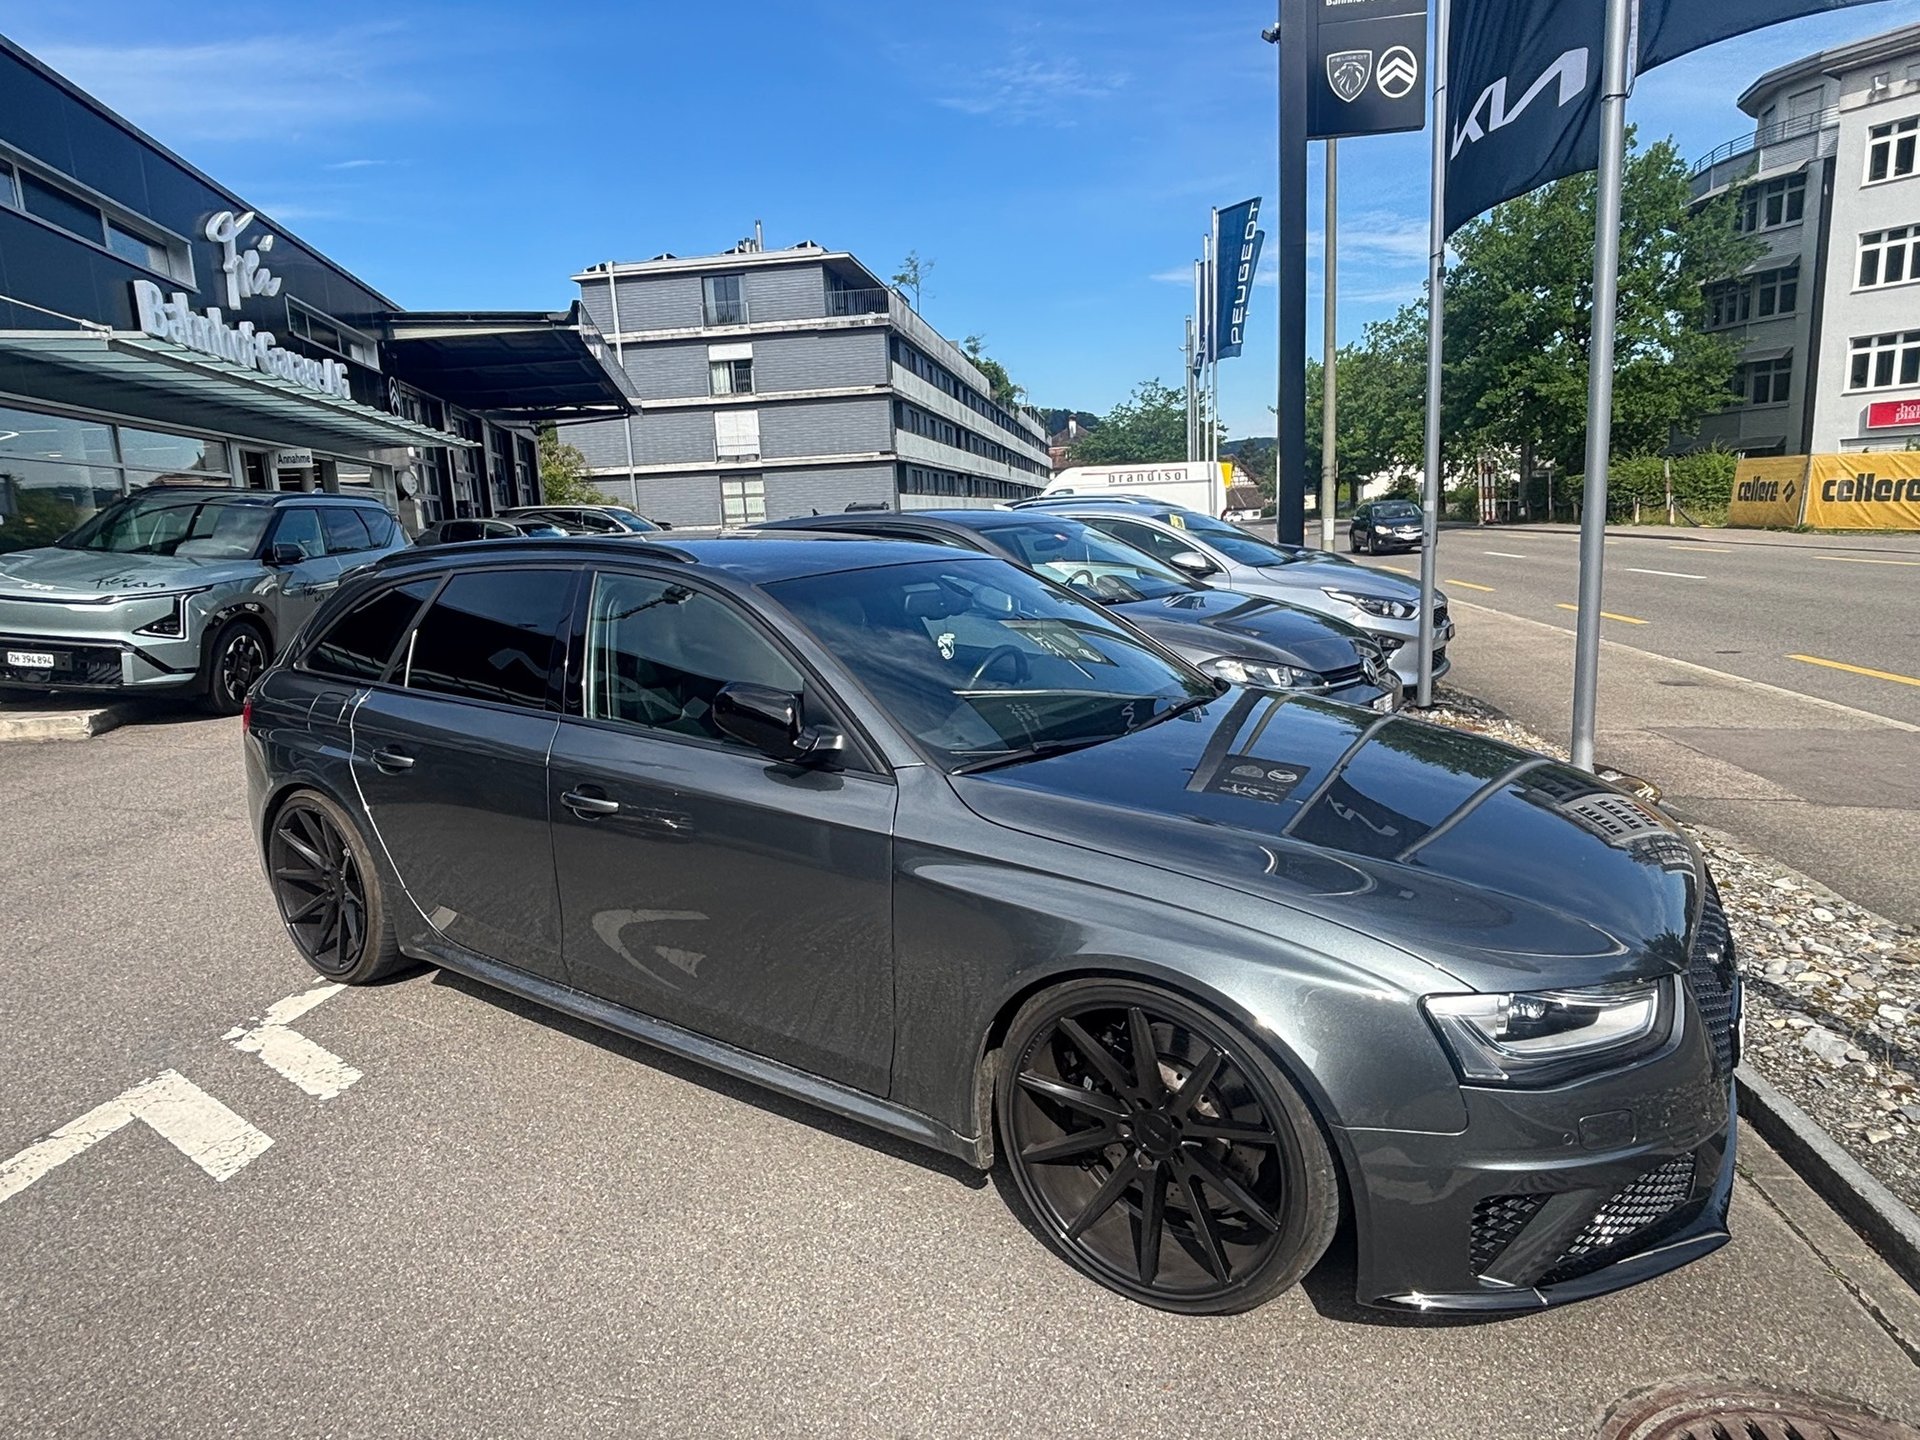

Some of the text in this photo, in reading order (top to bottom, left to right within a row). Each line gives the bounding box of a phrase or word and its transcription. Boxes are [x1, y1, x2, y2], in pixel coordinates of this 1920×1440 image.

[1331, 54, 1368, 63] PEUGEOT
[1230, 202, 1258, 344] PEUGEOT
[277, 452, 311, 464] Annahme
[1737, 475, 1779, 502] cellere
[1821, 473, 1920, 502] cellere
[9, 653, 52, 665] ZH 394 894
